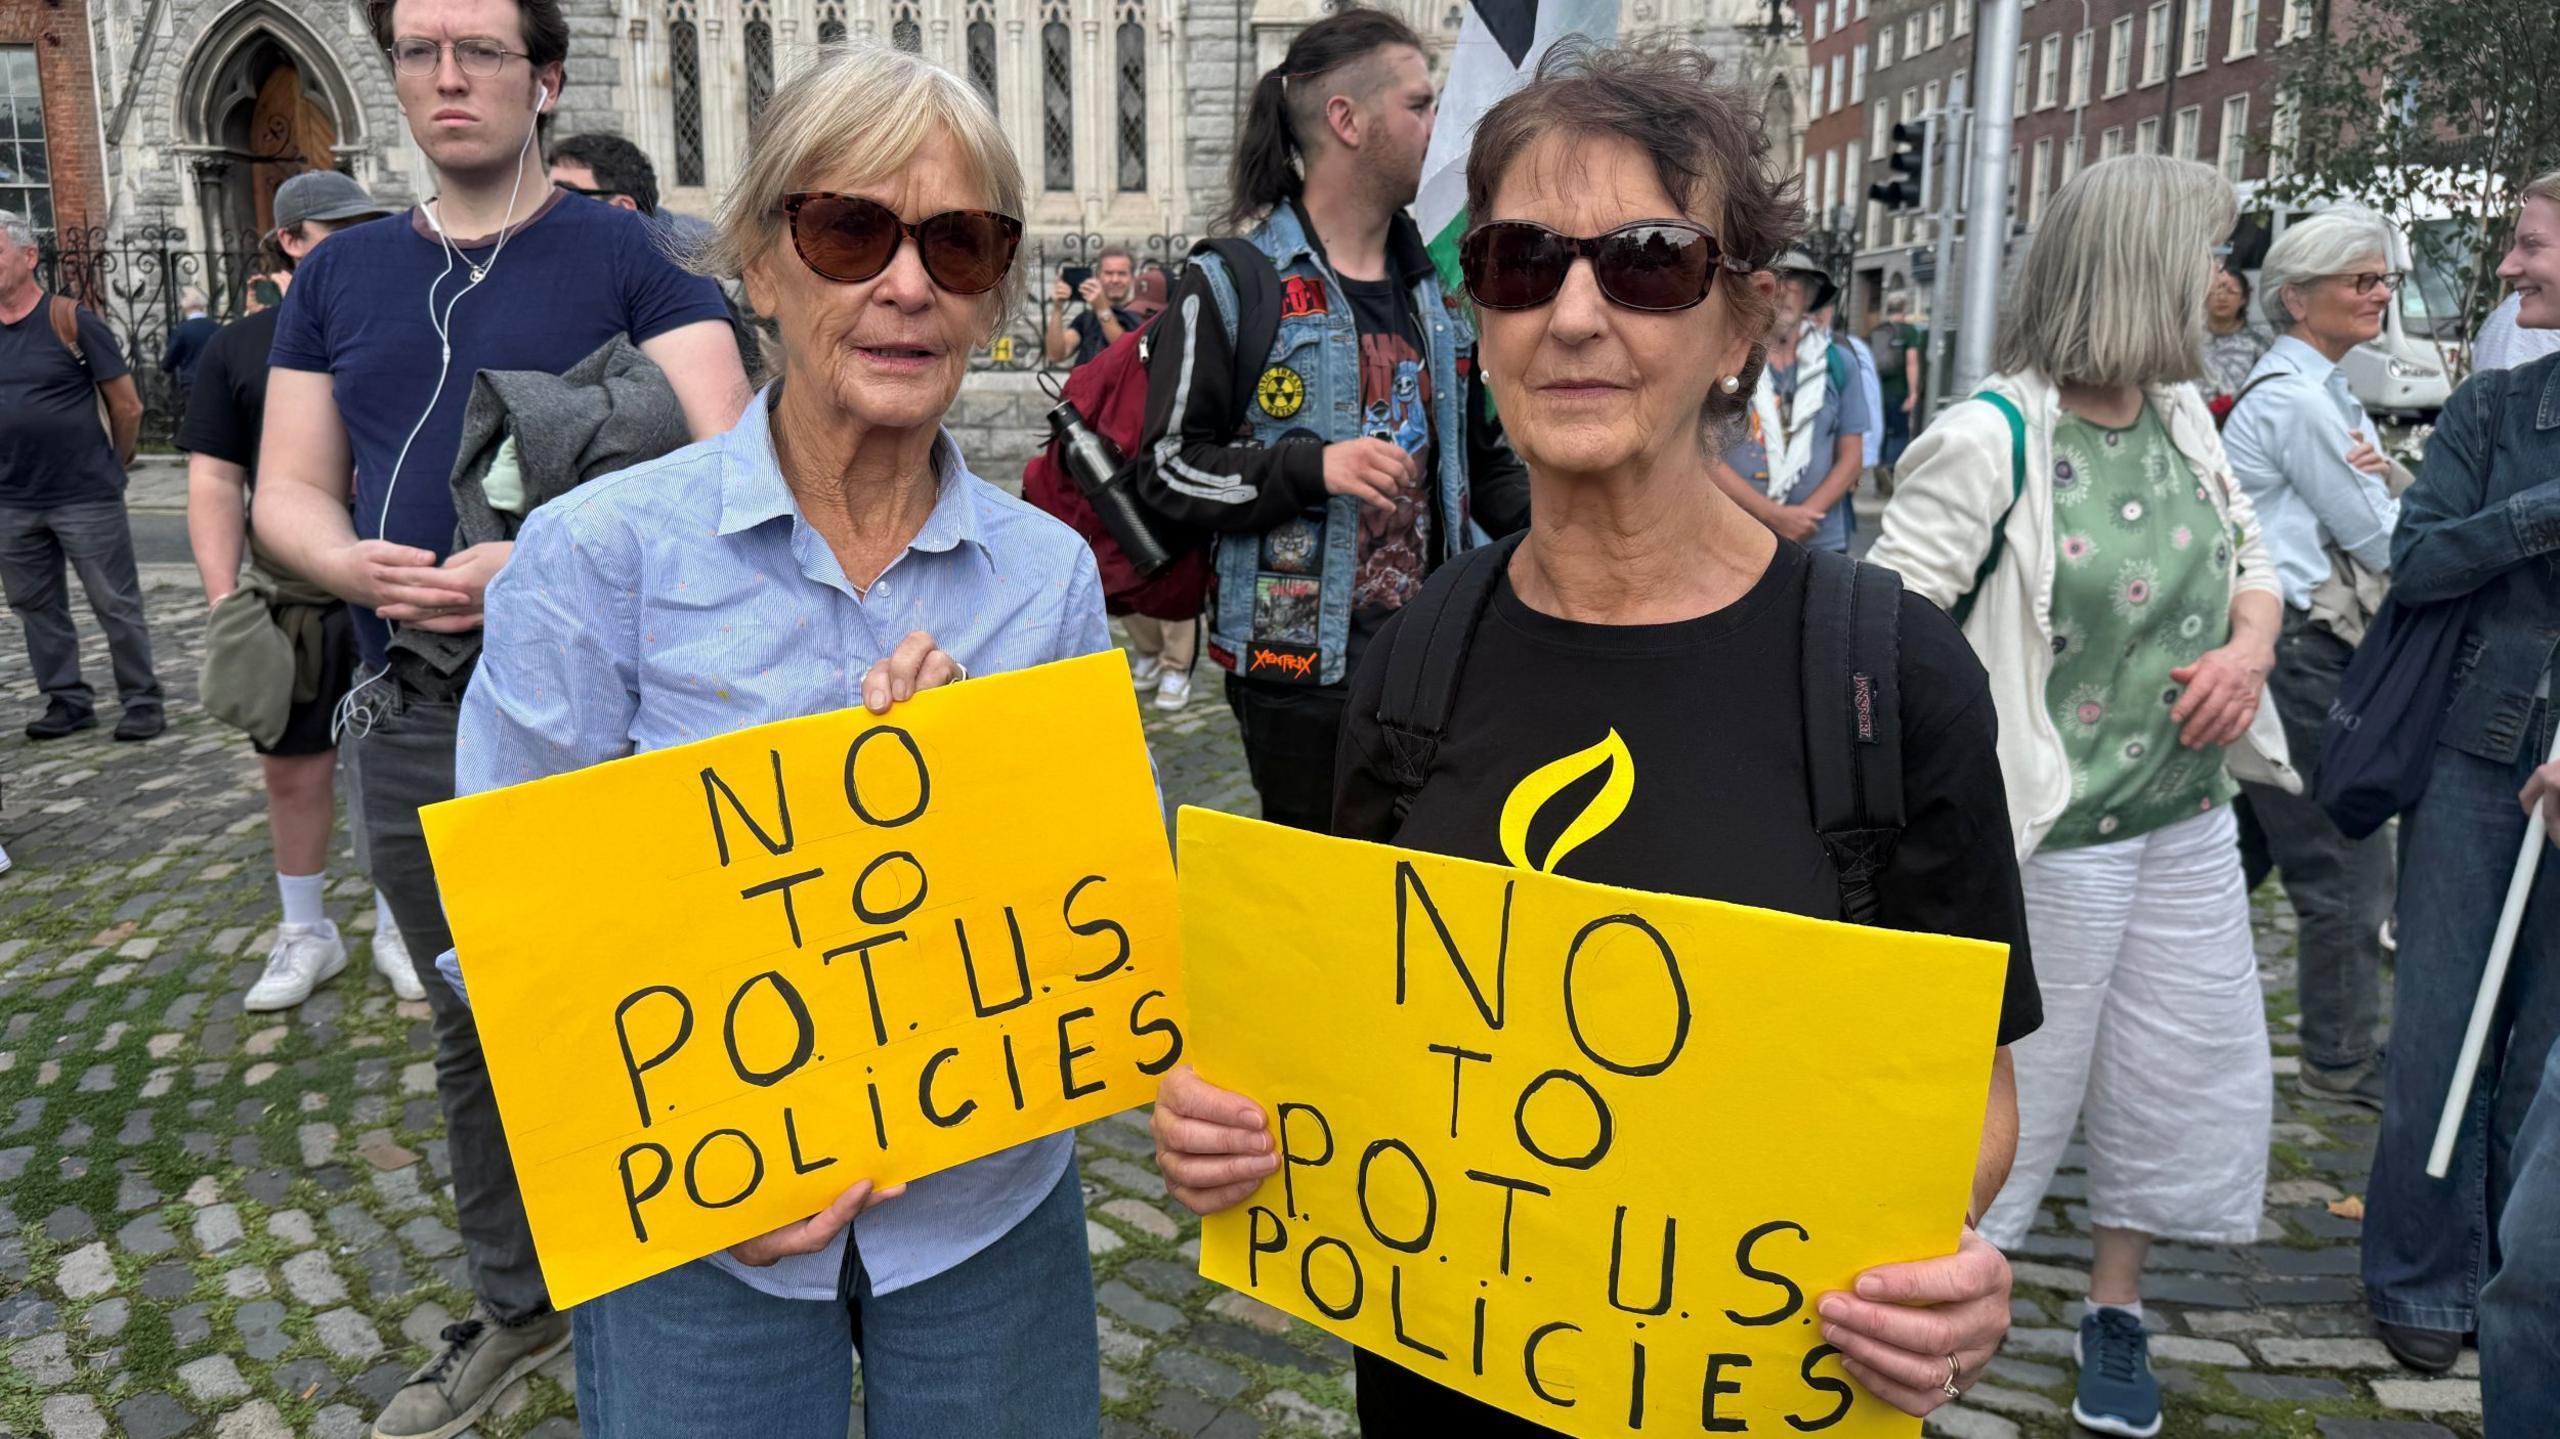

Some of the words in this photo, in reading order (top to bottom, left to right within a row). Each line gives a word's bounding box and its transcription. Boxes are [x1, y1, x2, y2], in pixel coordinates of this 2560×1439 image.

[701, 726, 929, 866] NO
[741, 852, 927, 948] TO
[1396, 862, 1691, 1075] NO
[616, 876, 1133, 1128] P.O.T.U.S.
[1429, 1044, 1612, 1170] TO
[1278, 1103, 1810, 1326] P.O.T.U.S.
